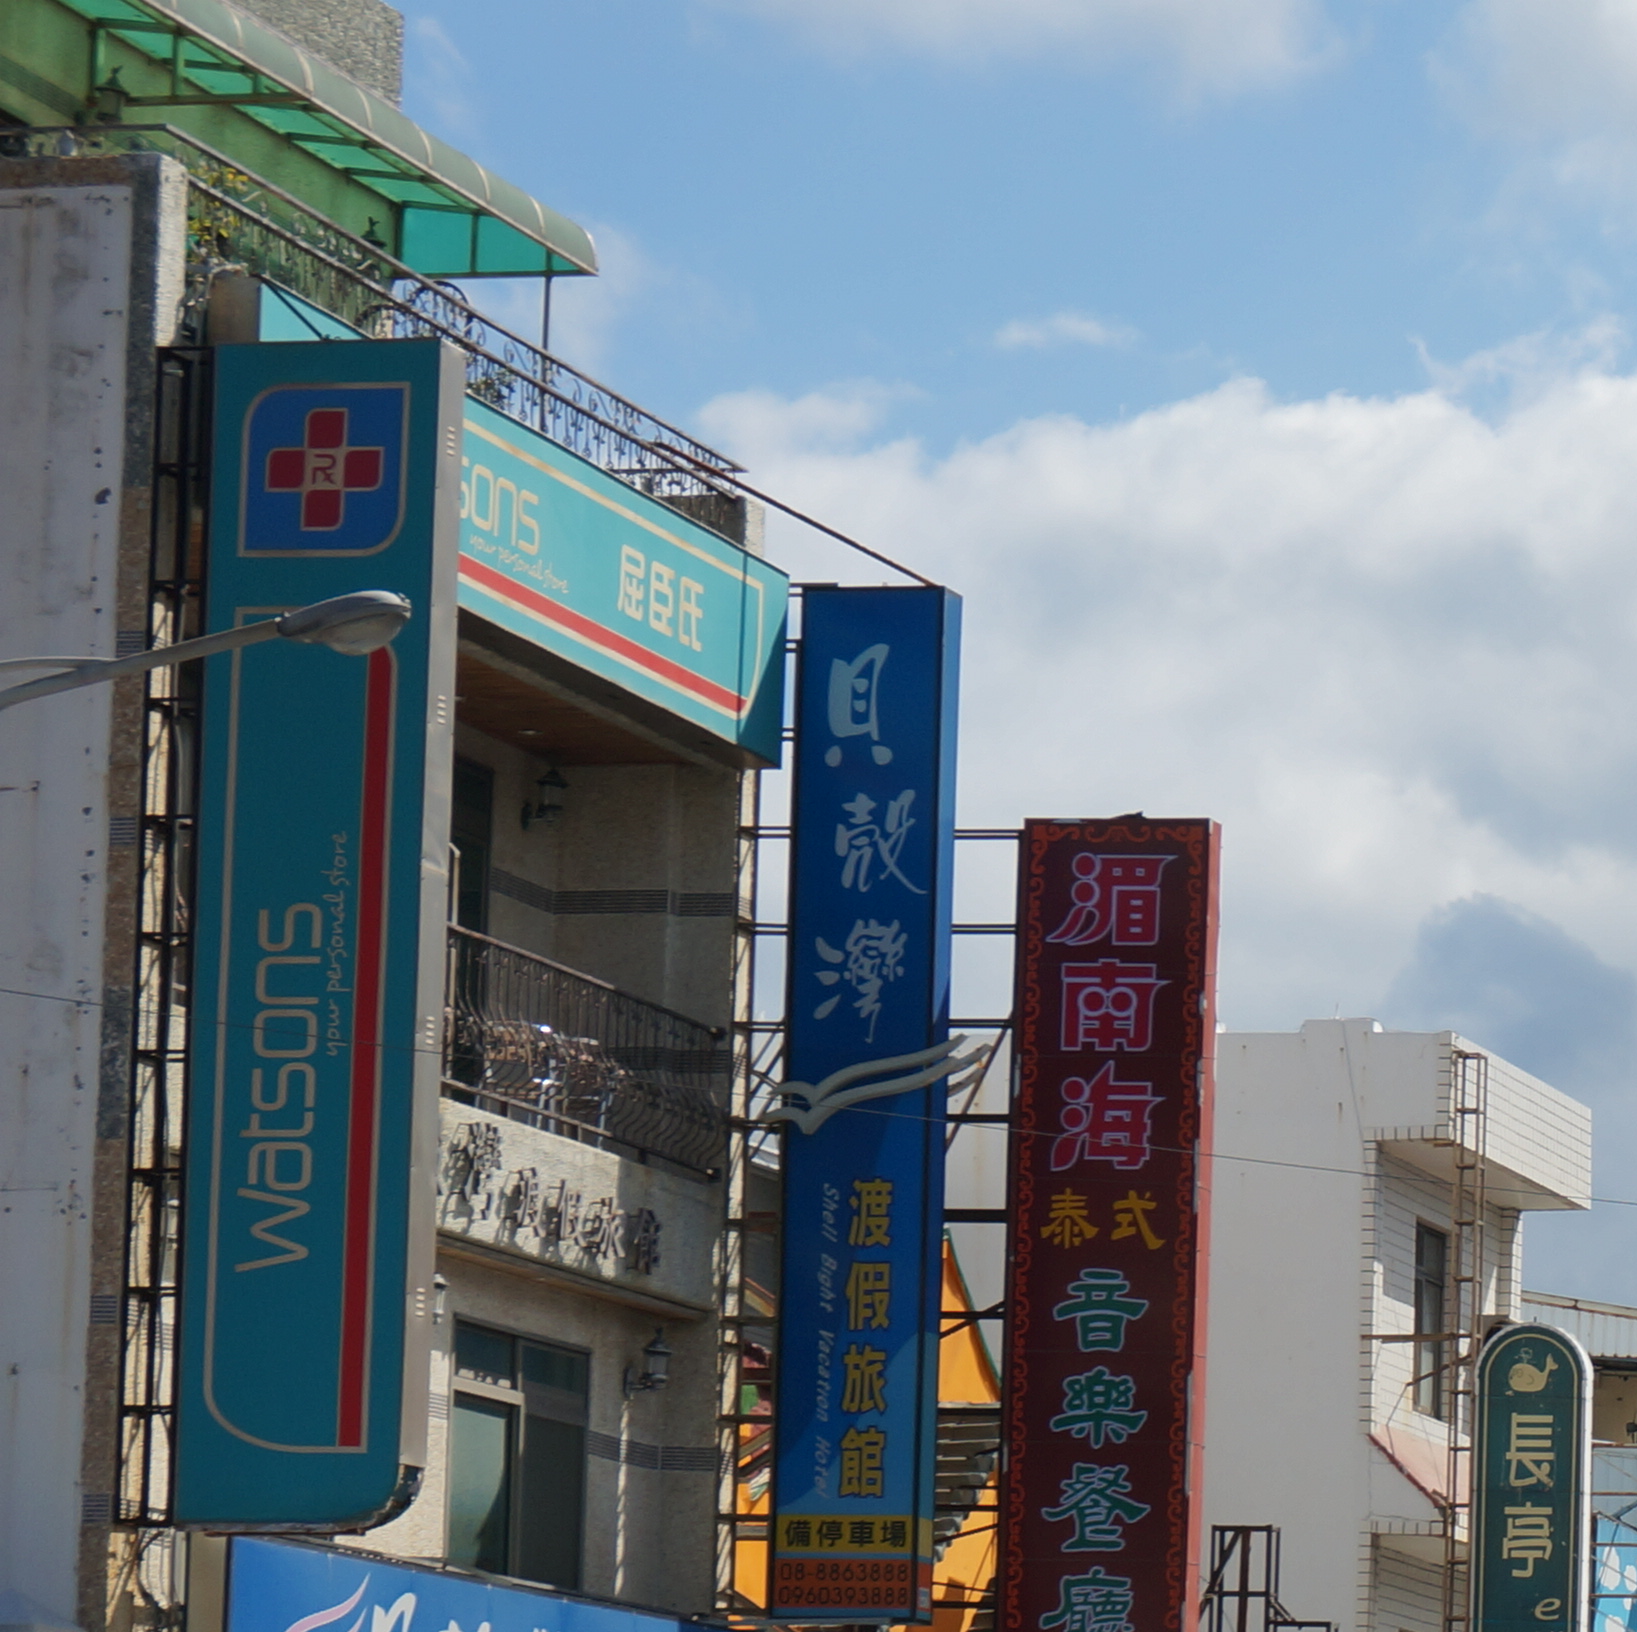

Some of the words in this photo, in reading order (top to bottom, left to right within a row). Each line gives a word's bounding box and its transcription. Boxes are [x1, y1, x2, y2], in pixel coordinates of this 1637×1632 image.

[618, 542, 704, 652] 屈臣氏
[814, 643, 928, 1043] 貝殼灣
[1046, 852, 1178, 1170] 湄南海
[235, 902, 322, 1274] Watsons
[822, 1182, 841, 1244] Shell
[1041, 1187, 1167, 1250] 泰式
[817, 1253, 838, 1313] Bight
[814, 1329, 837, 1423] Vacation
[838, 1178, 894, 1499] 渡假旅館
[784, 1520, 909, 1547] 備停車場
[1502, 1411, 1554, 1578] 長亭
[780, 1561, 909, 1583] 08-8863888
